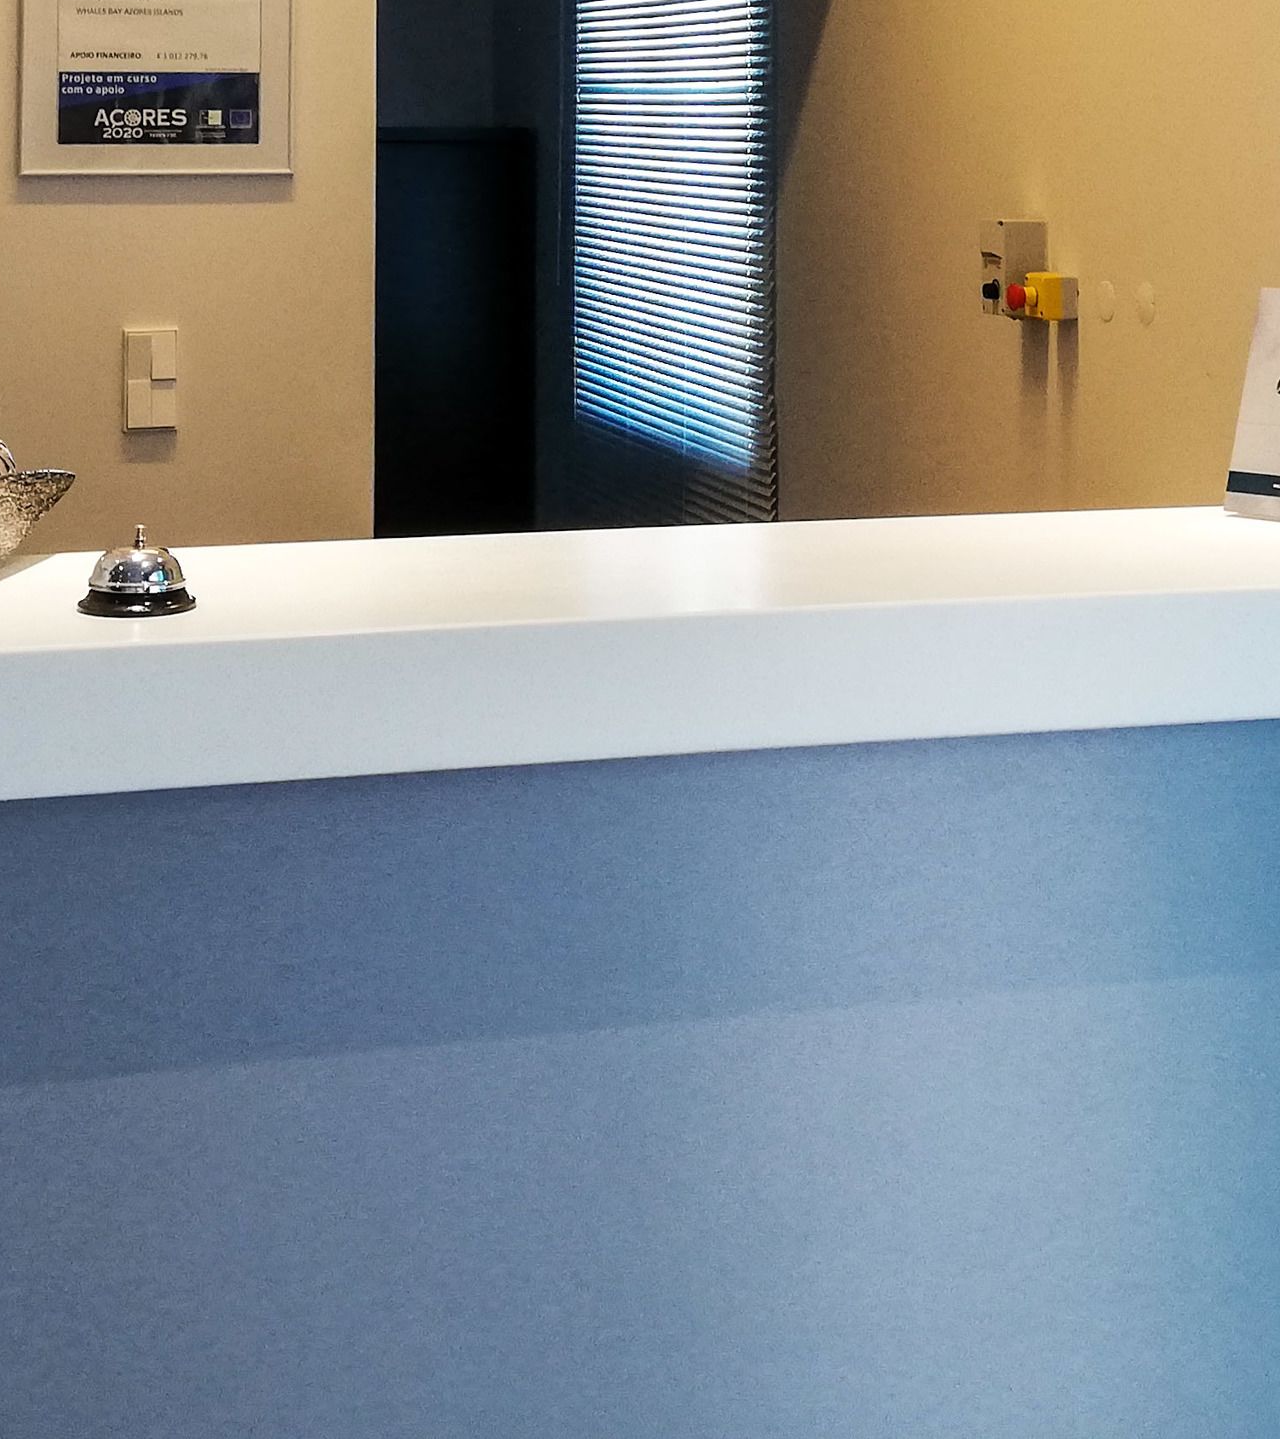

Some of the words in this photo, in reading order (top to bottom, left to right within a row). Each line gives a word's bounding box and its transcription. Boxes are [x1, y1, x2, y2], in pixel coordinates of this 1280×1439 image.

[75, 7, 107, 16] WHALES
[108, 7, 122, 16] BAY
[70, 51, 95, 60] APOIO
[61, 73, 104, 85] Projeto
[107, 75, 124, 83] em
[127, 75, 158, 83] curso
[61, 86, 84, 94] com
[86, 86, 93, 94] o
[95, 85, 125, 96] apoio
[93, 108, 188, 128] AÇORES
[102, 127, 144, 139] 2020
